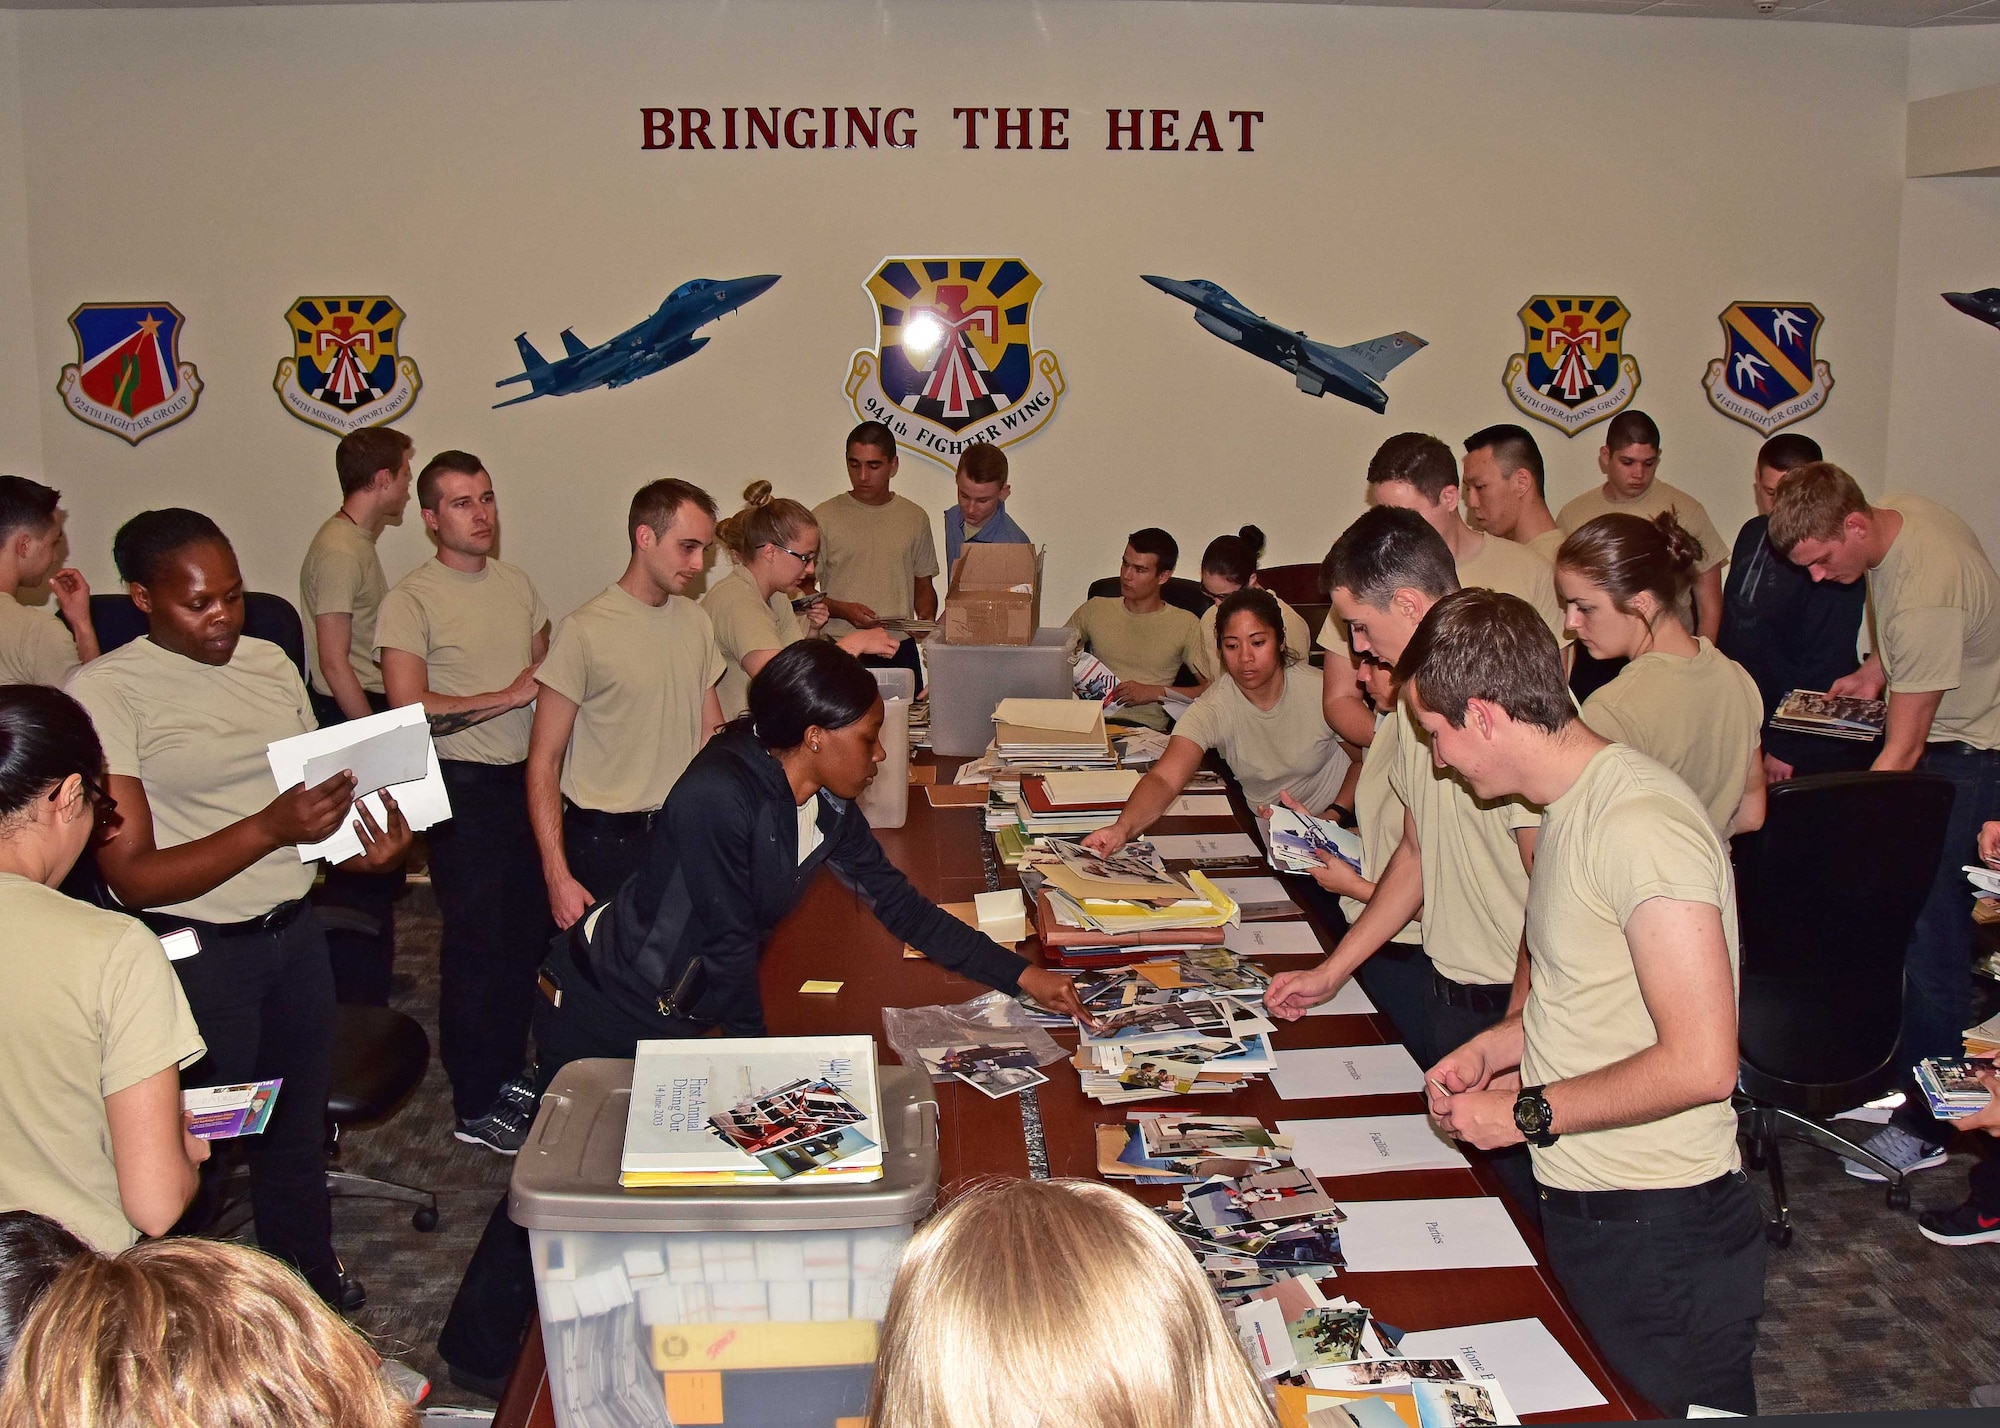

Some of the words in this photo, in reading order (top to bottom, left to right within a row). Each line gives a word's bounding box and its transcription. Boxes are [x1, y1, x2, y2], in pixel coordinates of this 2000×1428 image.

[640, 107, 918, 151] BRINGING
[953, 107, 1070, 151] THE
[1106, 108, 1265, 152] HEAT
[73, 396, 102, 419] 924TH
[104, 412, 152, 432] FIGHTER
[152, 395, 188, 421] GROUP
[288, 392, 311, 413] 944TH
[311, 407, 347, 428] MISSION
[348, 407, 384, 429] SUPPORT
[385, 387, 409, 413] GROUP
[1515, 386, 1540, 408] 944TH
[1540, 403, 1596, 424] OPERATIONS
[1597, 388, 1627, 411] GROUP
[1716, 392, 1743, 414] 414TH
[1742, 407, 1785, 427] FIGHTER
[1786, 392, 1820, 416] GROUP
[864, 397, 907, 437] 944th
[915, 426, 1003, 455] FIGHTER
[1000, 391, 1051, 431] WING
[653, 1094, 666, 1108] June
[667, 1078, 688, 1111] Dining
[689, 1078, 708, 1098] First
[652, 1109, 664, 1127] 2003
[669, 1112, 686, 1132] Out
[687, 1099, 707, 1132] Annual
[1425, 1221, 1445, 1245] Parties
[1459, 1346, 1485, 1371] Home
